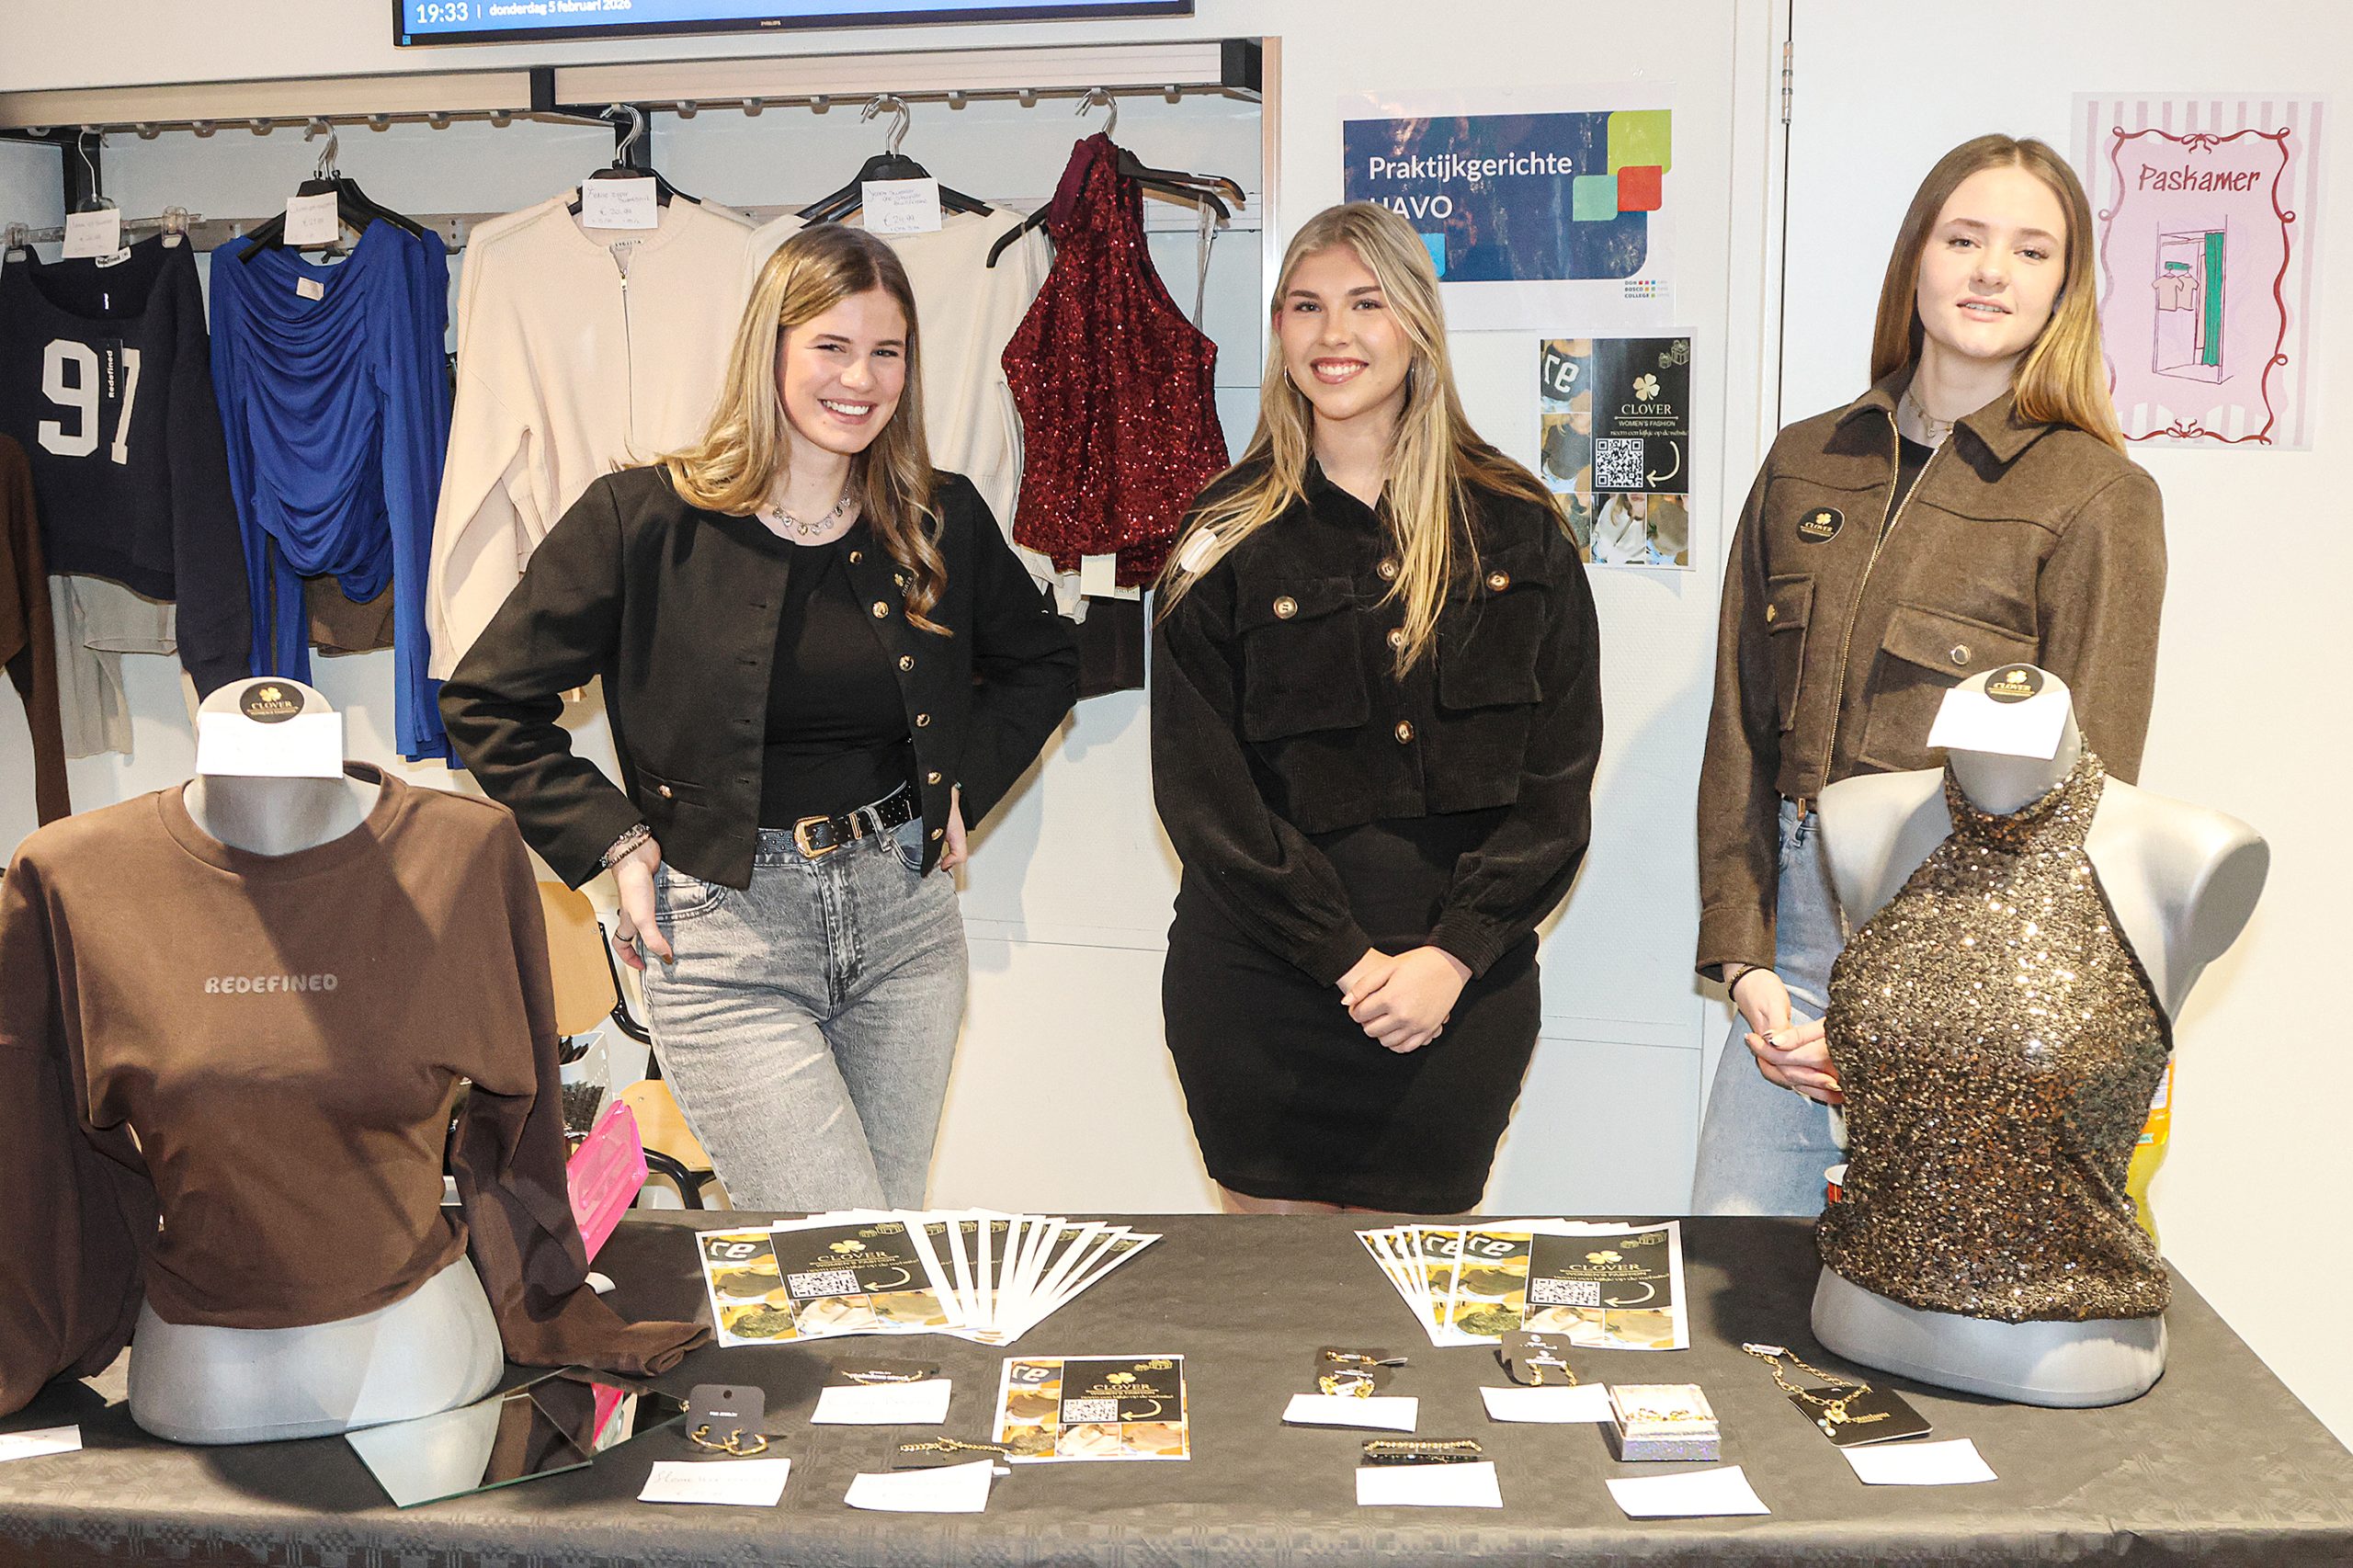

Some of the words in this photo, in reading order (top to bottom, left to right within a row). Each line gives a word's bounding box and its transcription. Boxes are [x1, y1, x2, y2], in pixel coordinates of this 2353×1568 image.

[416, 4, 469, 24] 19:33
[489, 2, 547, 16] donderdag
[549, 1, 556, 13] 5
[557, 0, 601, 12] februari
[602, 0, 631, 10] 2026
[1369, 152, 1573, 183] Praktijkgerichte
[2138, 164, 2261, 192] Paskamer
[106, 350, 115, 398] Redefined
[39, 338, 141, 465] 97
[1621, 403, 1672, 415] CLOVER
[1993, 682, 2032, 691] CLOVER
[251, 700, 293, 709] CLOVER
[204, 973, 338, 994] REDEFINED
[817, 1251, 889, 1262] CLOVER
